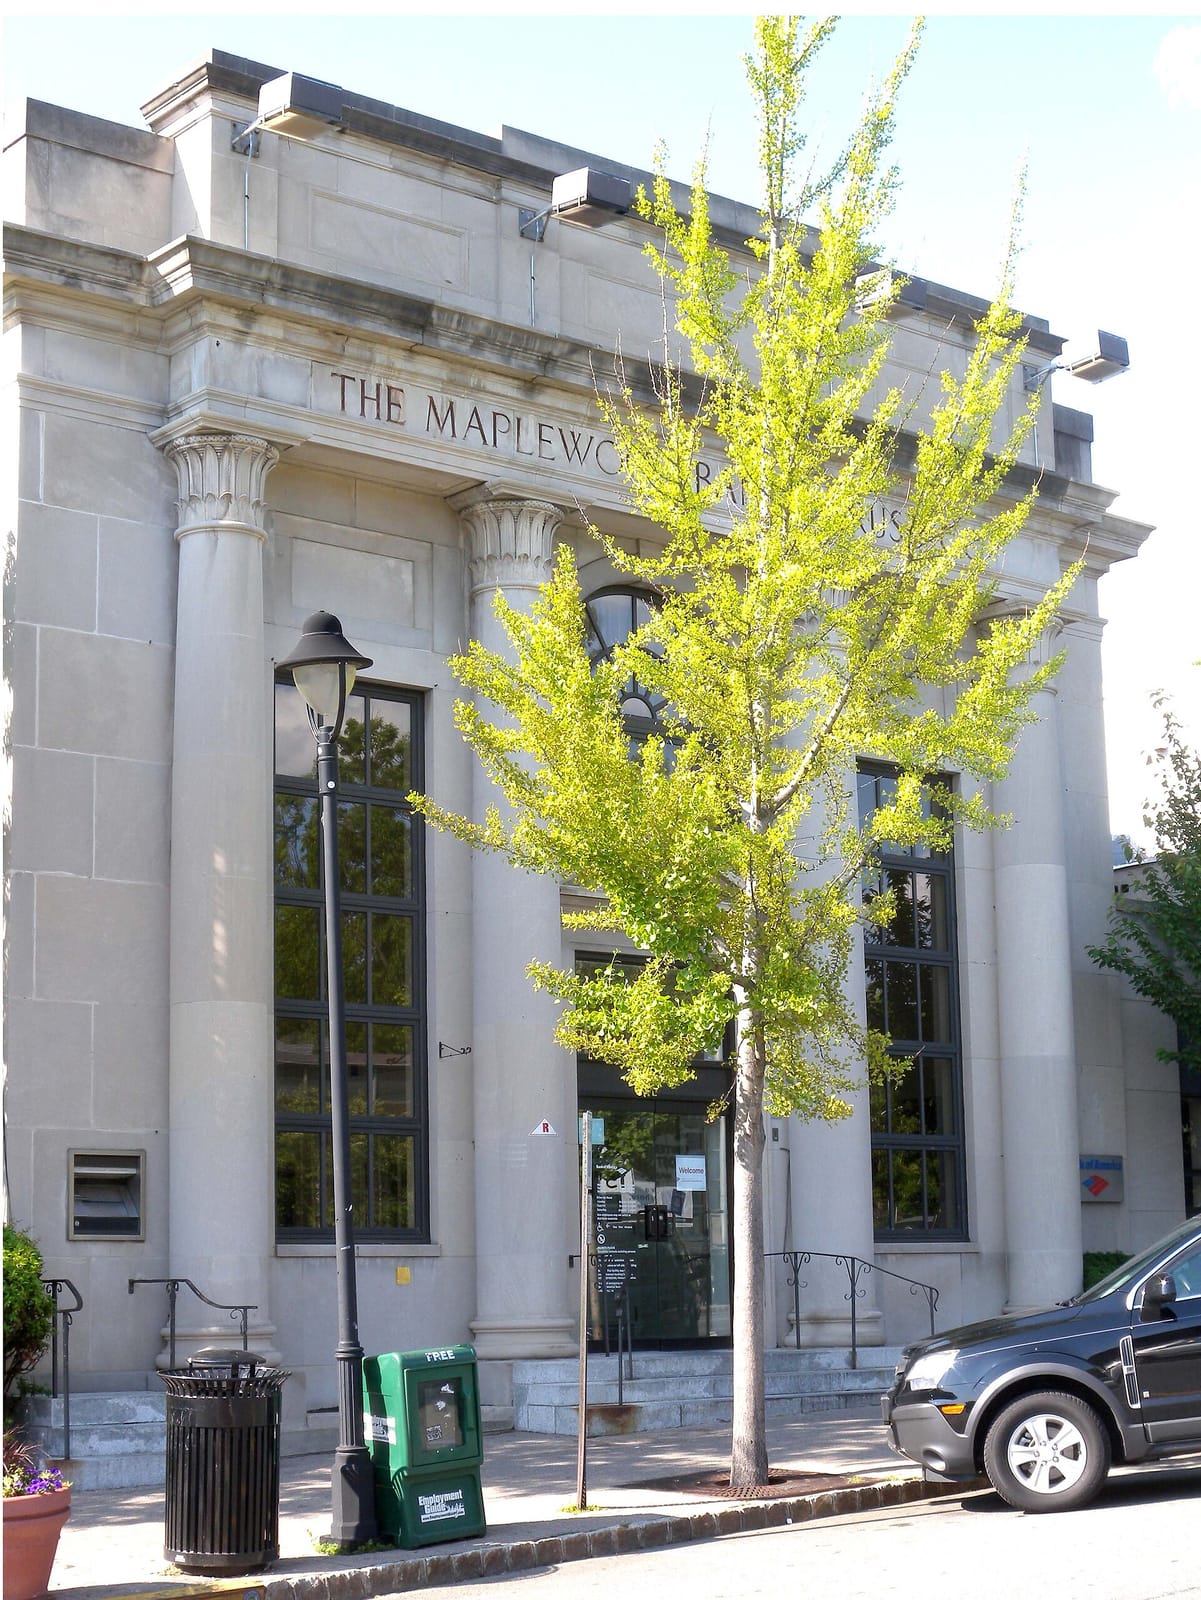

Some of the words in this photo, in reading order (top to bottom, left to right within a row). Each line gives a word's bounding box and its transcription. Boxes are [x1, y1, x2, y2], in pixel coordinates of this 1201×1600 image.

[331, 372, 406, 426] THE
[425, 394, 628, 476] MAPLEWO
[542, 1122, 550, 1133] R
[678, 1166, 704, 1174] Welcome
[426, 1349, 456, 1362] FREE
[418, 1490, 463, 1505] Employment
